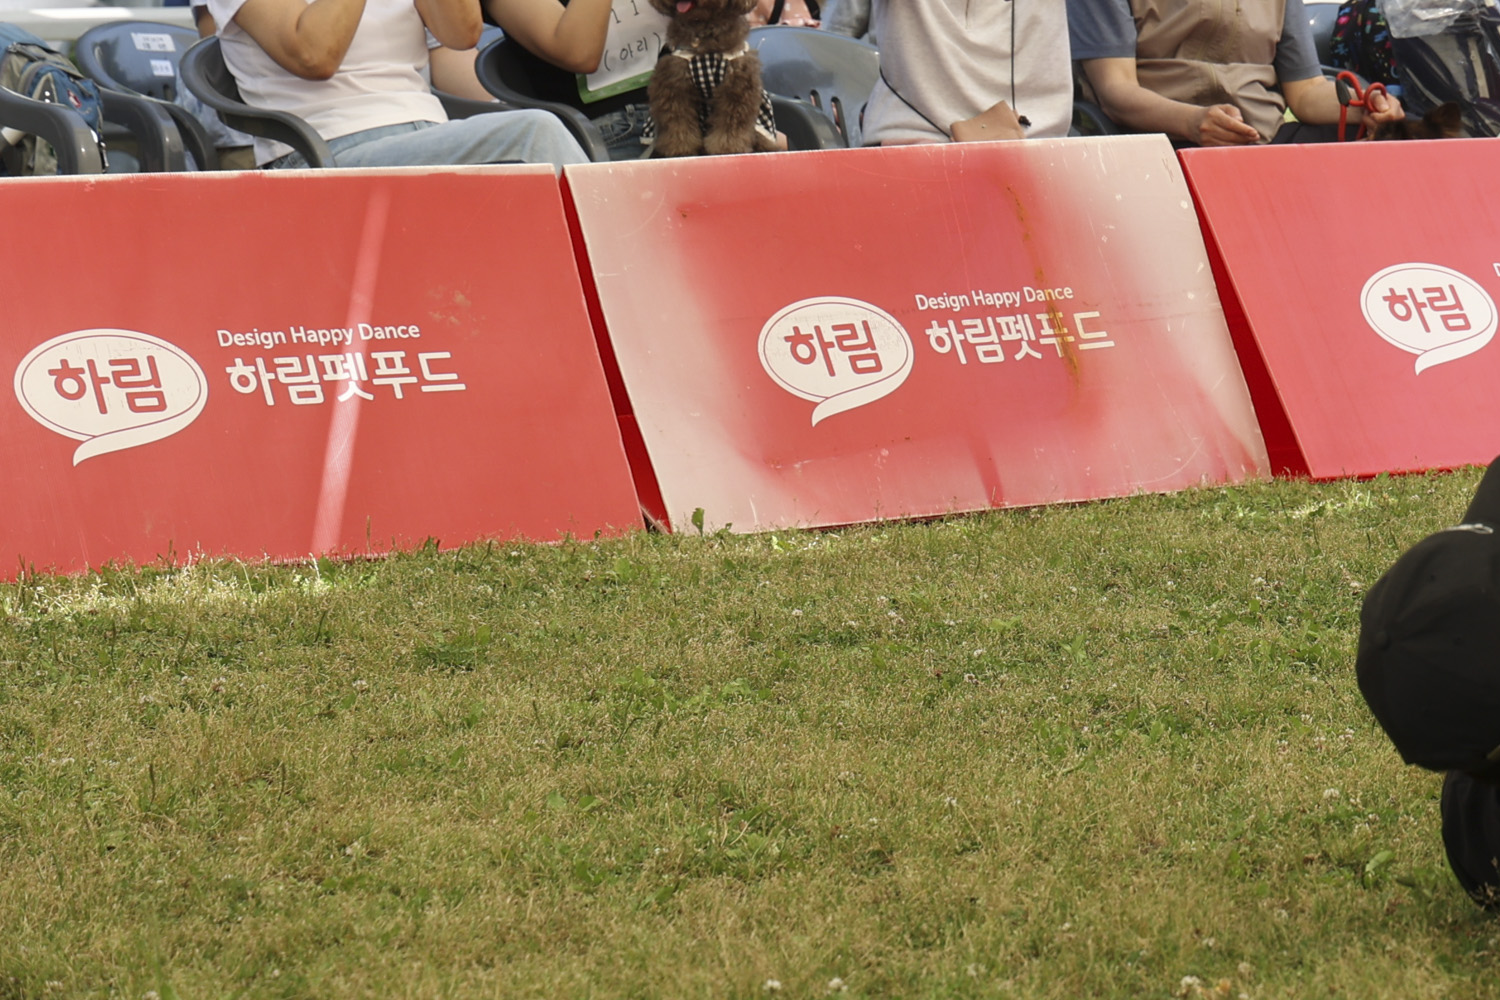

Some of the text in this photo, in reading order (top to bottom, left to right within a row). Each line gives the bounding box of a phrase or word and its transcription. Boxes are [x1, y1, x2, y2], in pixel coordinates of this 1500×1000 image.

[915, 285, 1074, 312] Design Happy Dance
[1382, 284, 1472, 333] 하림
[217, 321, 421, 350] Design Happy Dance
[783, 319, 883, 378] 하림
[925, 311, 1115, 365] 하림펫푸드
[47, 354, 168, 415] 하림
[225, 351, 467, 407] 하림펫푸드
